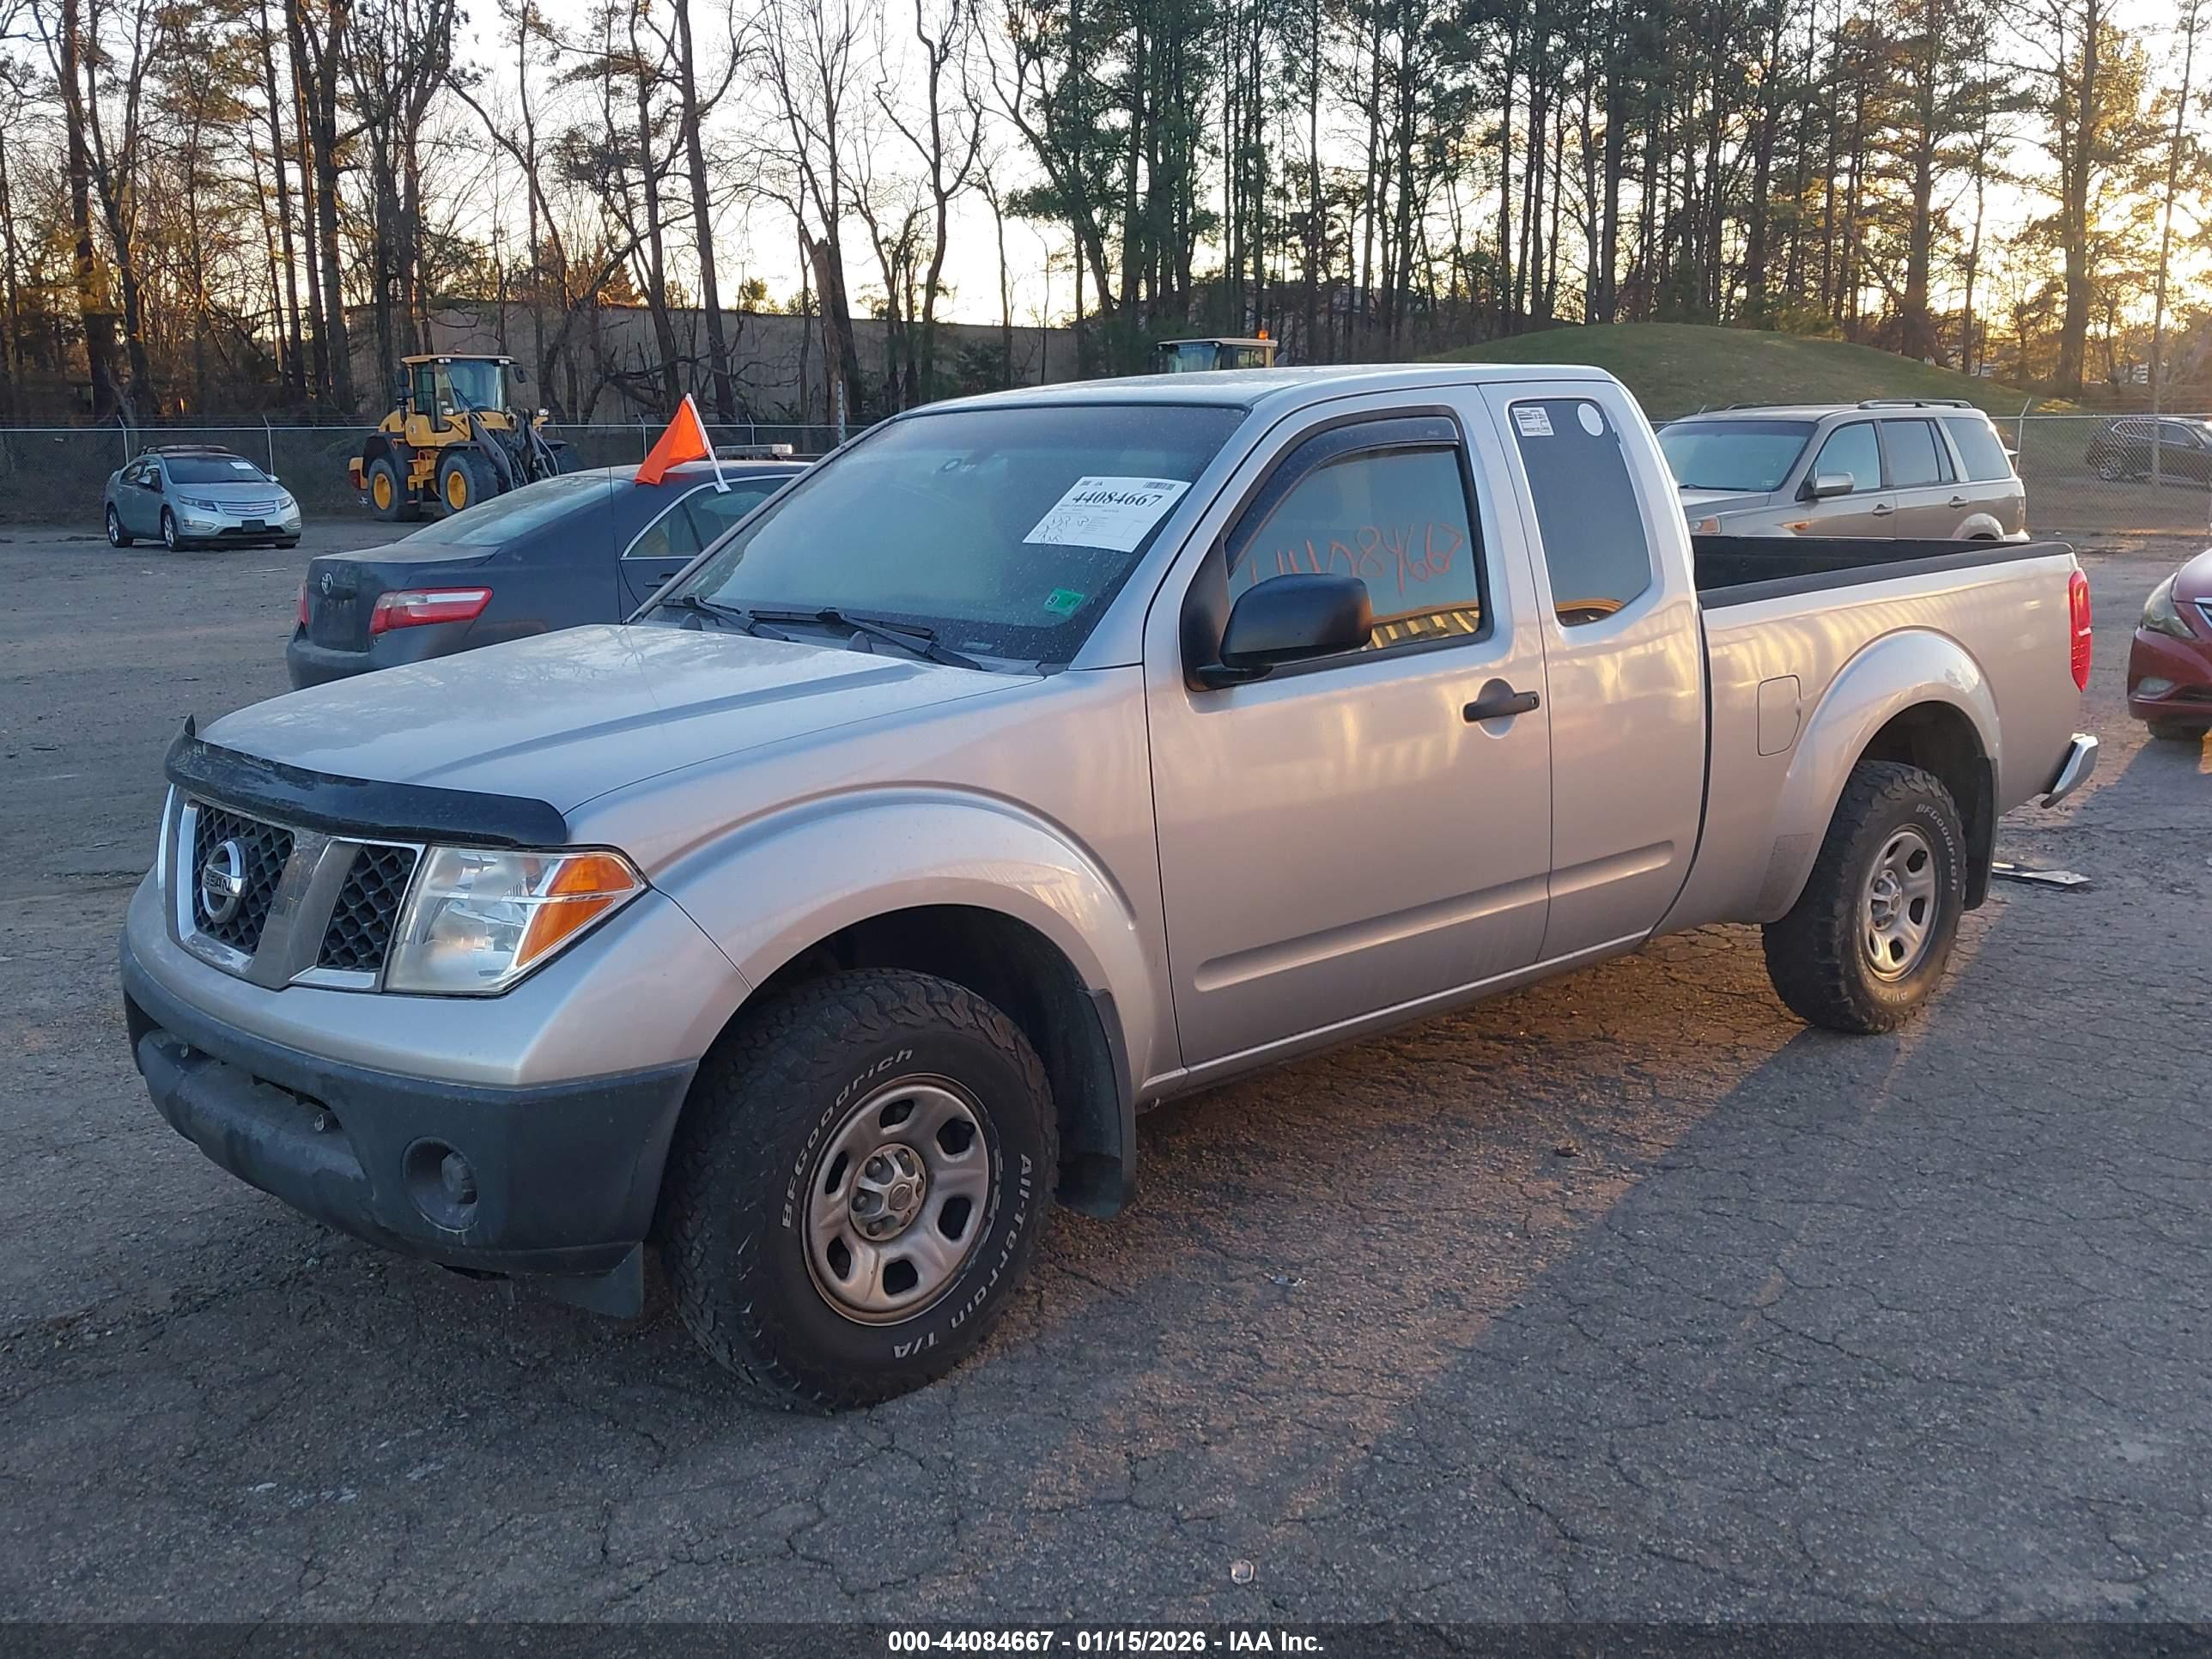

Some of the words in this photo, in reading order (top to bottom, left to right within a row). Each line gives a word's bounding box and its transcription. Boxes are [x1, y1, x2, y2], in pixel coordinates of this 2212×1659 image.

[1073, 490, 1164, 507] 44084667
[1916, 803, 1958, 891] BFGoodrich
[781, 1048, 913, 1228] BFGoodrich
[951, 1153, 1033, 1329] All-Terrain
[893, 1332, 939, 1359] T/A
